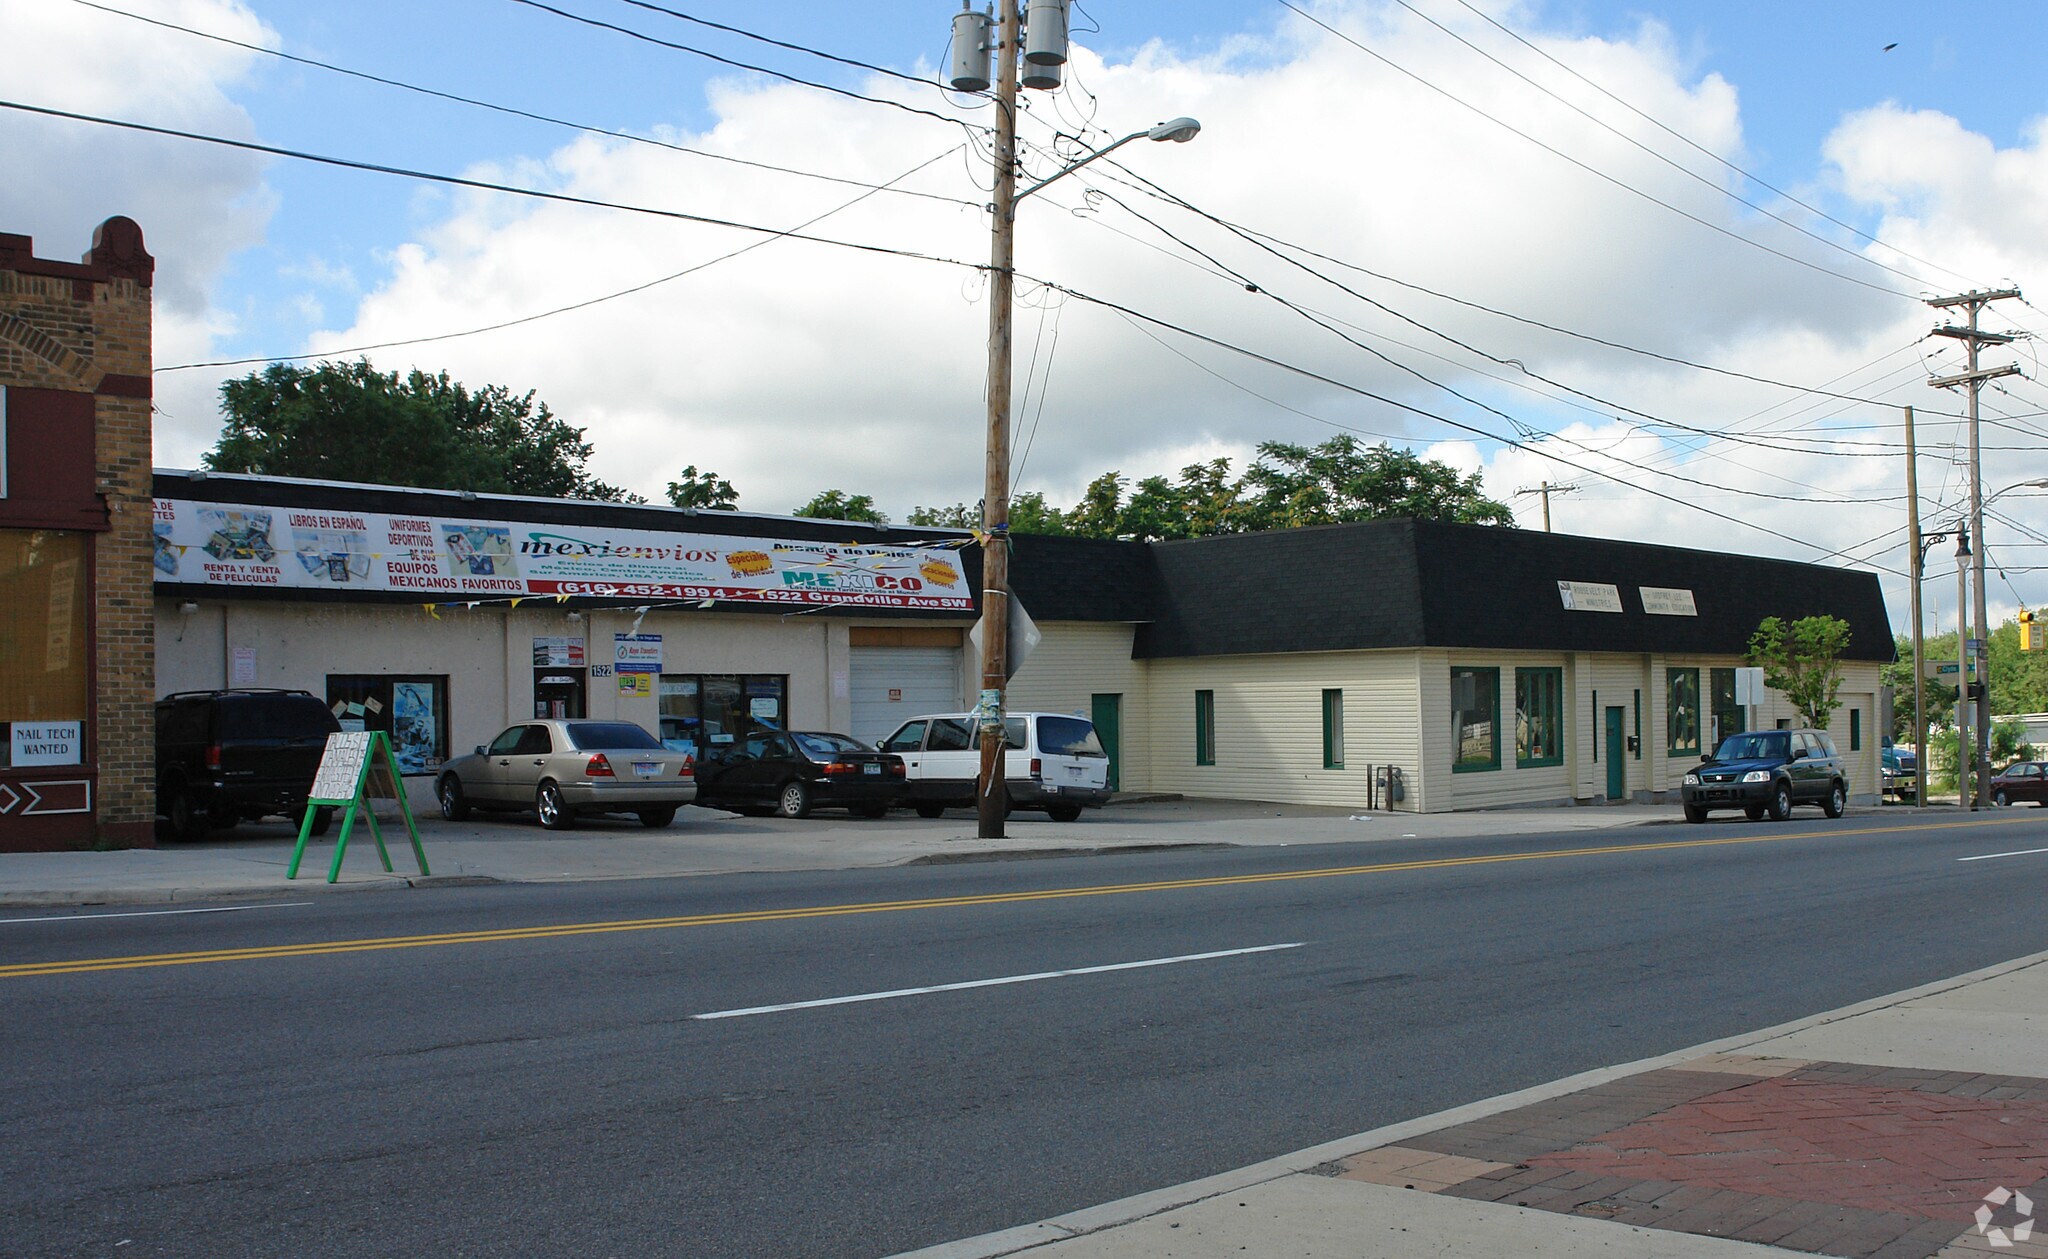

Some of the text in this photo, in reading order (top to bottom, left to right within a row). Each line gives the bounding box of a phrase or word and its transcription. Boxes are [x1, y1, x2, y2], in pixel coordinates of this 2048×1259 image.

[160, 501, 174, 511] DE
[288, 513, 367, 531] LIBROS EN ESPAÑOL
[389, 519, 432, 533] UNIFORMES
[388, 533, 434, 547] DEPORTIVOS
[409, 548, 436, 561] DE SUS
[520, 540, 718, 562] mexienvios
[773, 543, 838, 554] Agenca
[844, 547, 863, 555] de
[725, 552, 769, 565] Especiales
[203, 563, 281, 575] RENTA Y VENTA
[387, 562, 438, 575] EQUIPOS
[731, 569, 742, 579] de
[209, 573, 278, 584] DE PELICULAS
[389, 575, 522, 590] MEXICANOS FAVORITOS
[781, 570, 923, 591] MEXICO
[557, 582, 967, 607] (616) 452-1994 1522 Grandville Ave SW
[1573, 586, 1617, 597] ROOSEVELT PARK
[1585, 599, 1612, 608] MINISTRIES
[592, 665, 611, 677] 1522
[17, 728, 75, 740] NAIL TECH
[24, 743, 69, 755] WANTED
